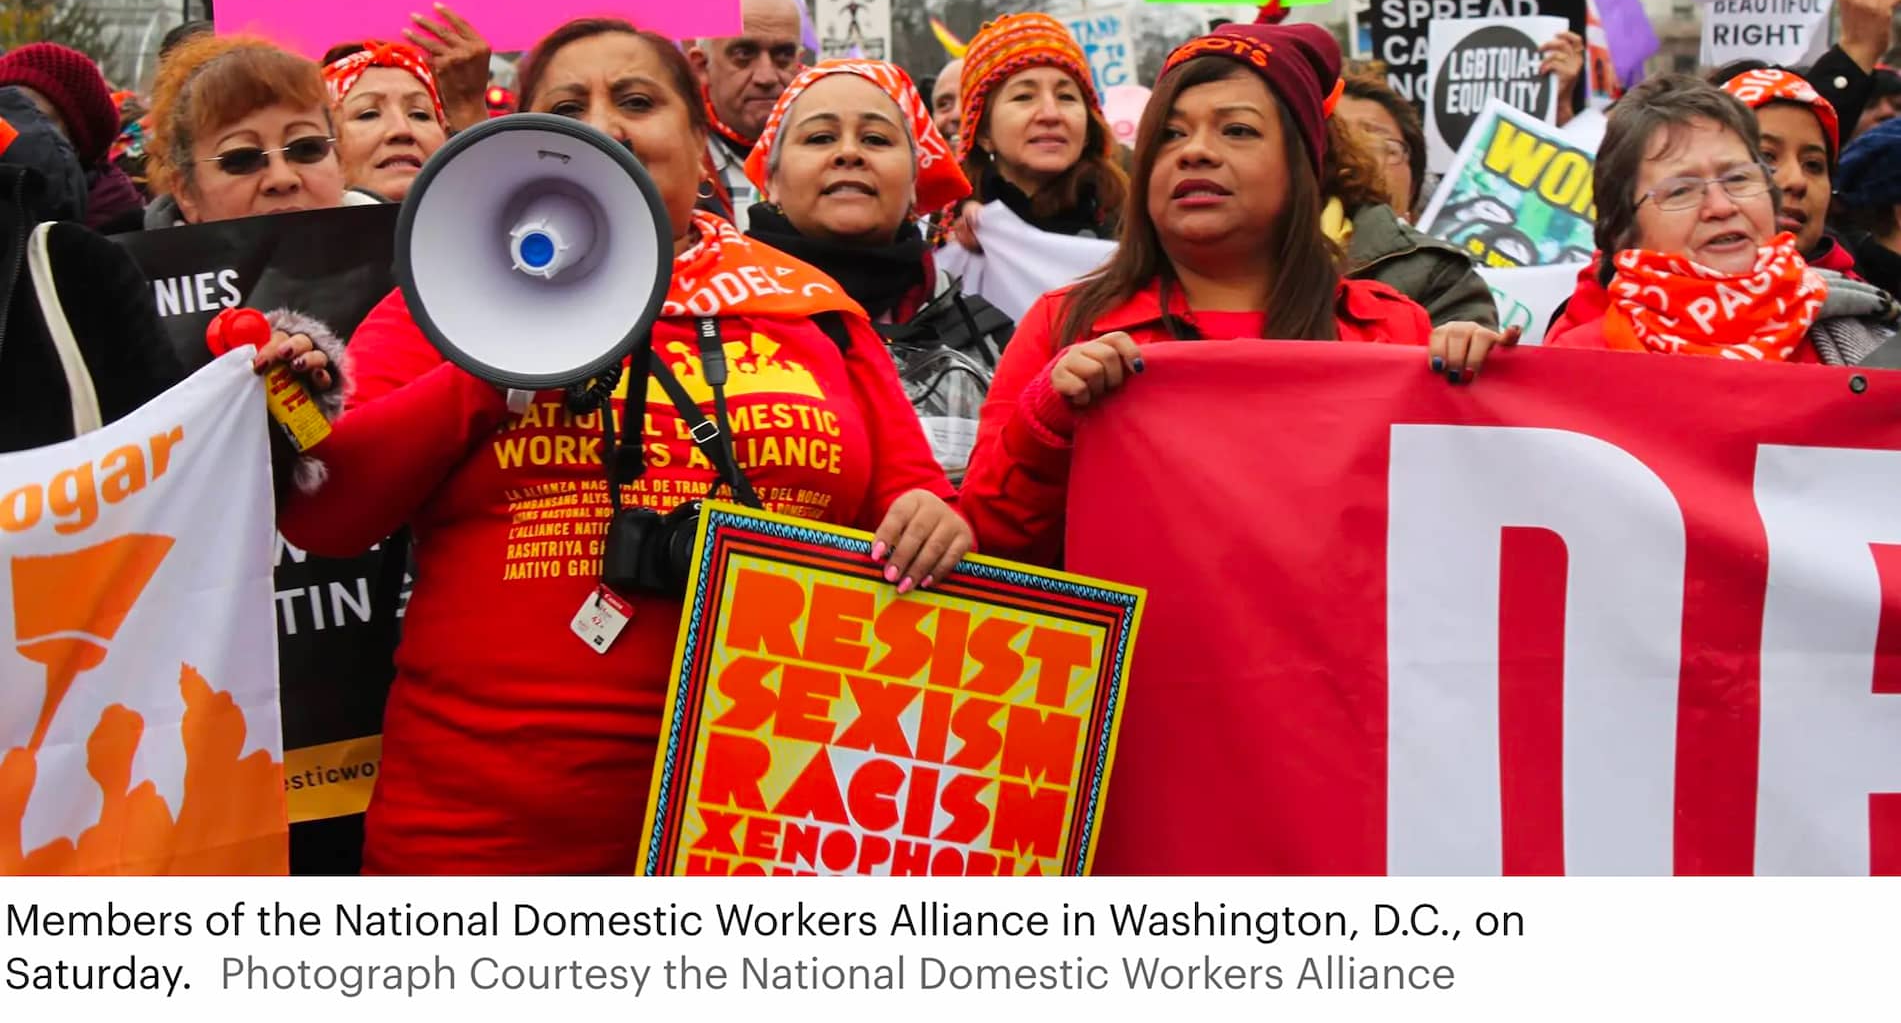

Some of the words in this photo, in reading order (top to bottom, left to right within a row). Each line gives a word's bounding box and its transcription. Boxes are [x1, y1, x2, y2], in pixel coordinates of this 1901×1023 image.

[1713, 24, 1804, 46] RIGHT
[1446, 81, 1542, 115] EQUALITY
[687, 436, 842, 474] ALIANCE
[653, 479, 670, 492] DE
[770, 487, 793, 501] DEL
[507, 541, 583, 560] RASHTRIYA
[503, 560, 561, 580] JAATIYO
[725, 568, 1092, 708] RESIST
[711, 656, 1081, 785] SEXISM
[698, 731, 1068, 860] RACISM
